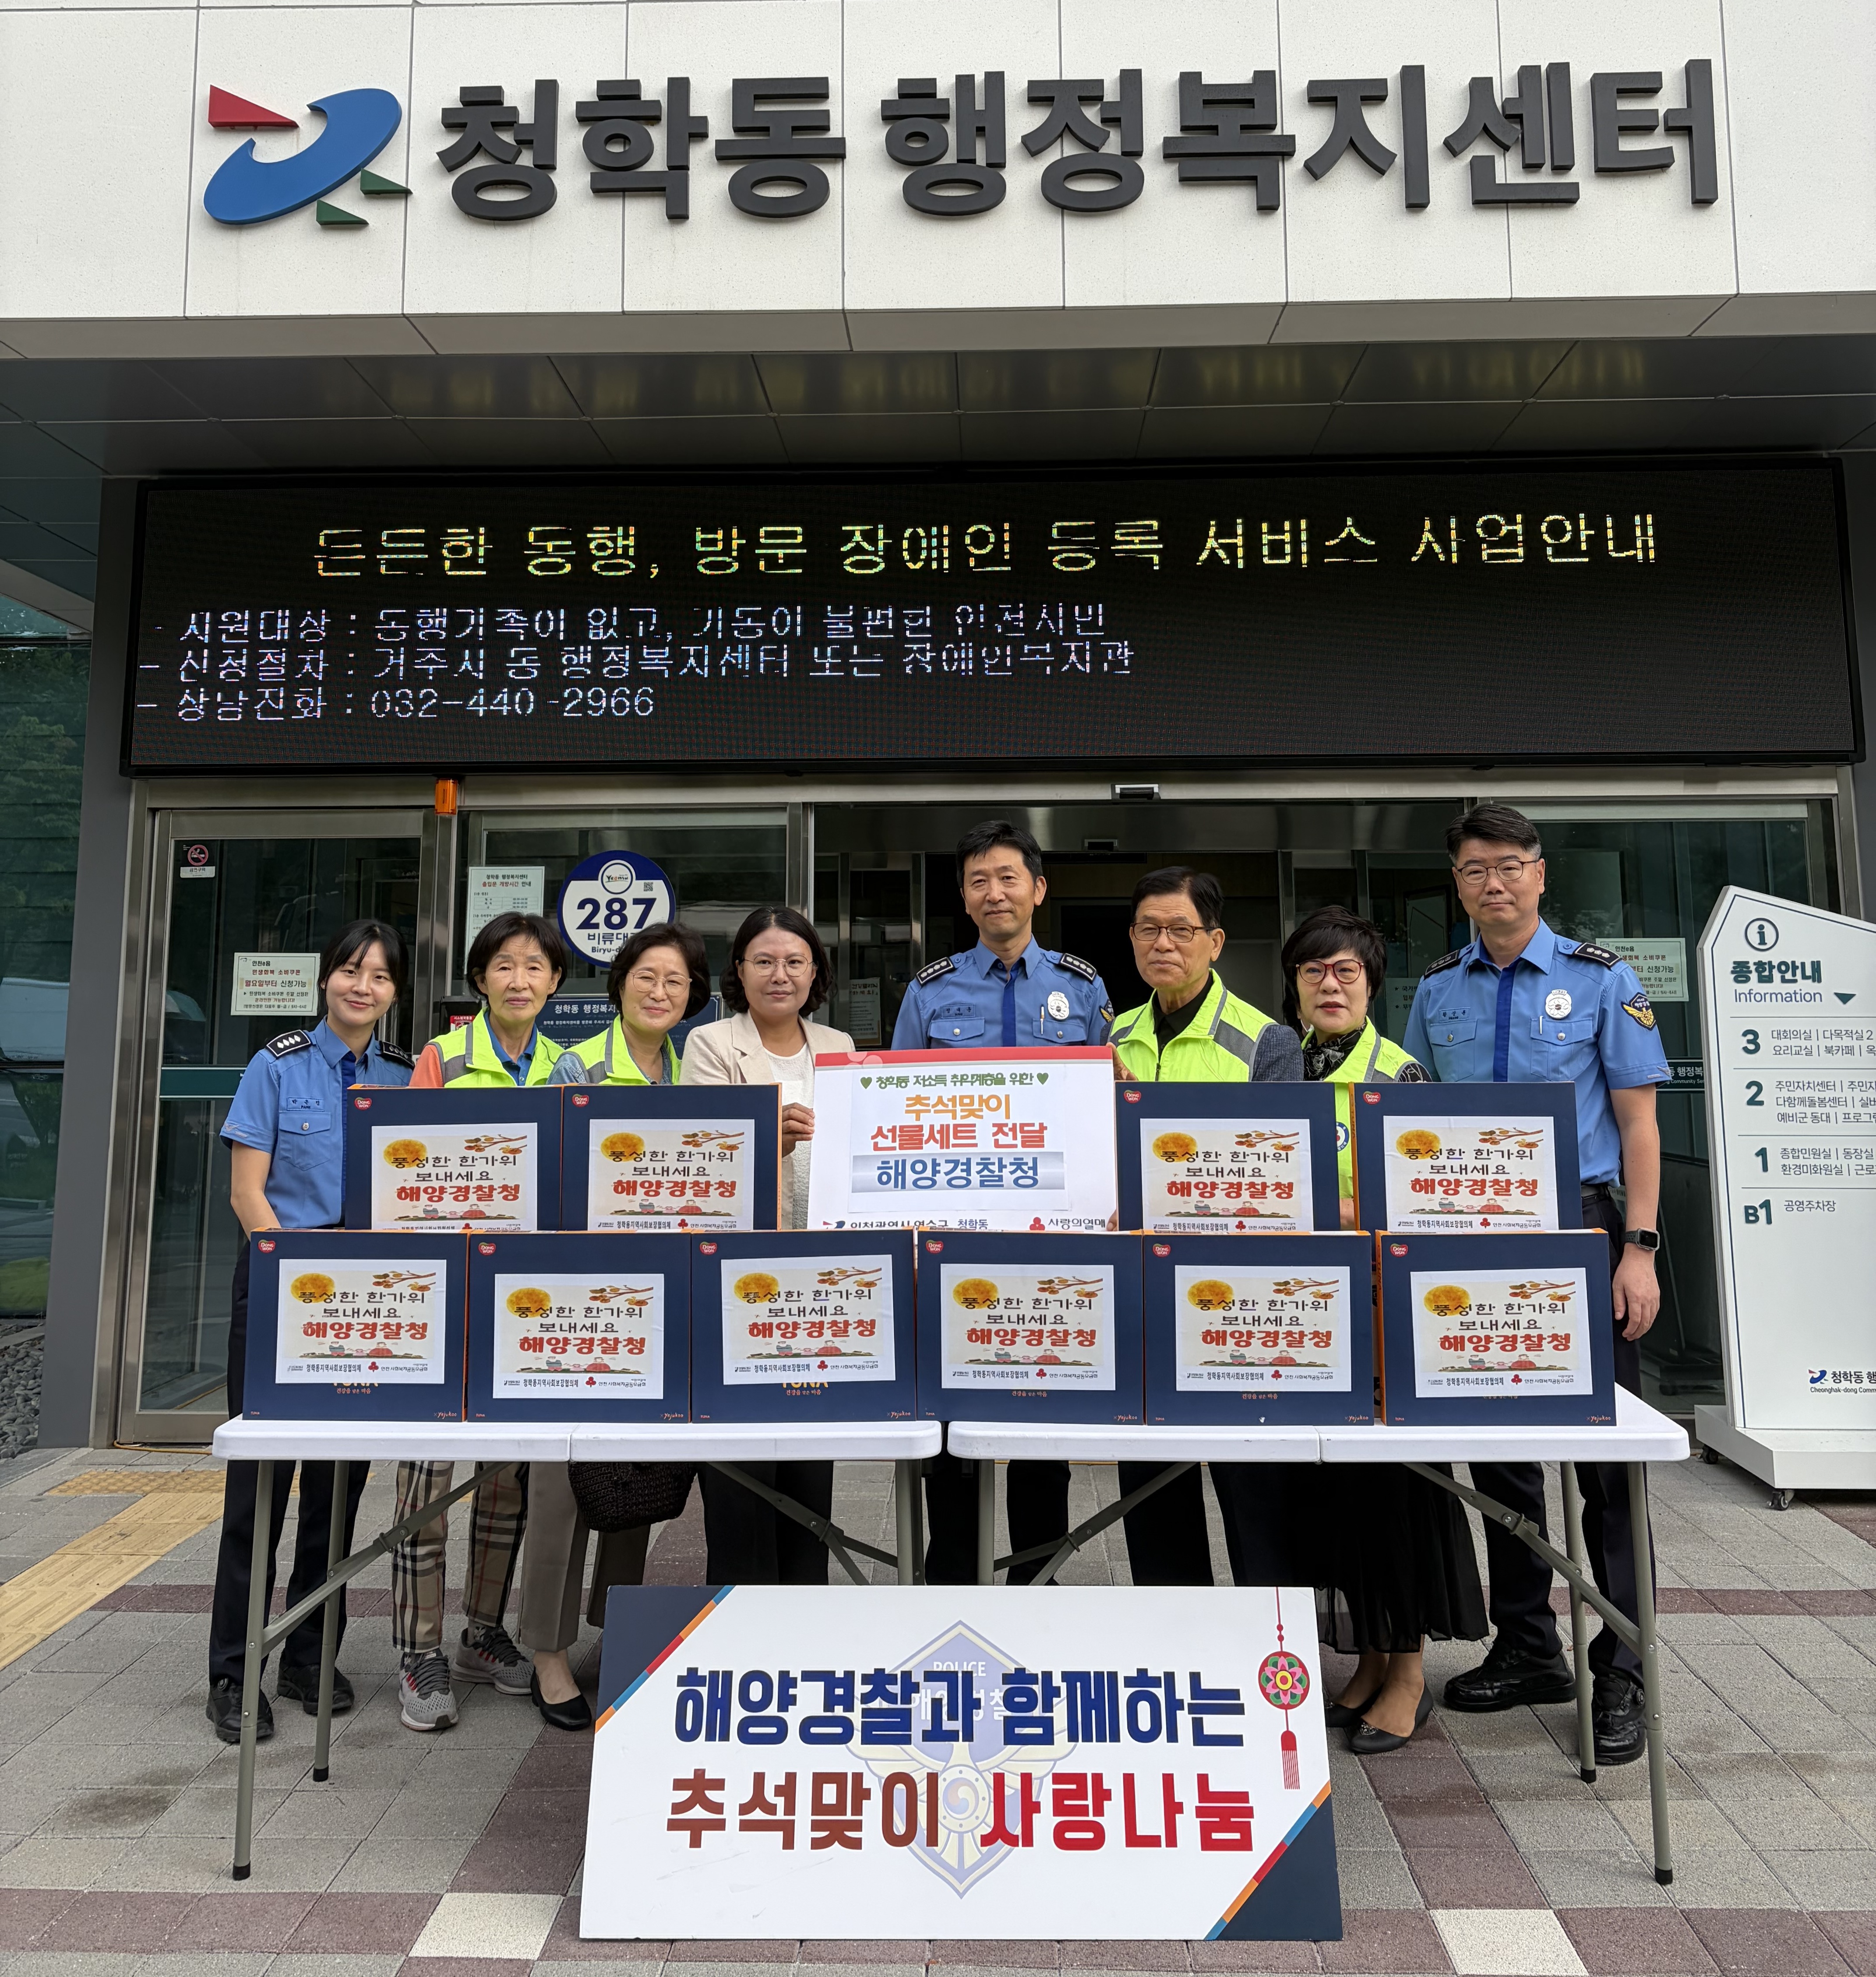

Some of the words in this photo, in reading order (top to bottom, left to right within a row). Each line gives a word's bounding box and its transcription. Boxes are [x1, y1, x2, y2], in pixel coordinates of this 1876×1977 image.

[437, 76, 846, 221] 청학동
[881, 59, 1718, 216] 행정복지센터
[314, 526, 493, 576] 든든한
[523, 525, 658, 578] 동행,
[695, 525, 808, 574] 방문
[840, 523, 1012, 574] 장애인
[1047, 521, 1164, 571] 등록
[1196, 517, 1378, 569] 서비스
[1411, 514, 1655, 564] 사업안내
[371, 687, 654, 717] 032-440-2966
[576, 898, 657, 930] 287
[588, 933, 636, 945] 비류대
[1731, 960, 1822, 983] 종합안내
[1735, 989, 1822, 1003] Information
[555, 1004, 578, 1014] 청학동
[1771, 1029, 1812, 1041] 대회의실
[1823, 1029, 1864, 1041] 다목적실
[1742, 1029, 1761, 1055] 3
[1773, 1045, 1813, 1056] 요리교실
[1824, 1045, 1855, 1056] 북카페
[876, 1076, 910, 1088] 청학동
[913, 1075, 947, 1087] 저소득
[950, 1073, 1006, 1086] 취약계층을
[1009, 1073, 1034, 1085] 위한
[1775, 1080, 1836, 1092] 주민자치센터
[1746, 1080, 1764, 1106] 2
[905, 1094, 1010, 1121] 추석맞이
[1776, 1096, 1848, 1108] 다함께돌봄센터
[1777, 1112, 1808, 1124] 예비군
[1810, 1112, 1830, 1124] 동대
[871, 1124, 978, 1152] 선물세트
[991, 1122, 1047, 1149] 전달
[608, 1151, 668, 1163] 풍성한
[676, 1151, 733, 1163] 한가위
[1160, 1151, 1221, 1163] 풍성한
[1230, 1152, 1289, 1163] 한가위
[1404, 1148, 1465, 1160] 풍성한
[1474, 1149, 1533, 1160] 한가위
[1755, 1147, 1768, 1172] 1
[1780, 1148, 1831, 1159] 종합민원실
[1843, 1148, 1874, 1160] 동장실
[391, 1156, 451, 1169] 풍성한
[458, 1156, 516, 1166] 한가위
[631, 1166, 710, 1177] 보내세요
[877, 1156, 1038, 1190] 해양경찰청
[1185, 1167, 1266, 1178] 보내세요
[1429, 1164, 1510, 1175] 보내세요
[1781, 1164, 1844, 1176] 환경미화원실
[415, 1171, 494, 1182] 보내세요
[396, 1184, 520, 1203] 해양경찰청
[613, 1180, 737, 1198] 해양경찰청
[1167, 1181, 1294, 1199] 해양경찰청
[1410, 1178, 1538, 1196] 해양경찰청
[1744, 1199, 1772, 1225] B1
[1784, 1200, 1836, 1212] 공영주차장
[1048, 1218, 1105, 1230] 사랑의열매
[298, 1291, 359, 1304] 풍성한
[367, 1292, 425, 1303] 한가위
[742, 1290, 804, 1303] 풍성한
[812, 1289, 872, 1301] 한가위
[961, 1297, 1023, 1310] 풍성한
[1032, 1298, 1092, 1310] 한가위
[1195, 1299, 1259, 1311] 풍성한
[1267, 1300, 1328, 1311] 한가위
[1432, 1304, 1496, 1316] 풍성한
[1504, 1303, 1566, 1314] 한가위
[321, 1307, 401, 1318] 보내세요
[514, 1306, 575, 1318] 풍성한
[583, 1307, 642, 1318] 한가위
[767, 1305, 848, 1318] 보내세요
[986, 1314, 1068, 1325] 보내세요
[1221, 1315, 1304, 1326] 보내세요
[1459, 1319, 1542, 1331] 보내세요
[302, 1322, 428, 1340] 해양경찰청
[539, 1322, 619, 1333] 보내세요
[748, 1319, 876, 1339] 해양경찰청
[966, 1328, 1097, 1347] 해양경찰청
[1201, 1329, 1332, 1348] 해양경찰청
[1439, 1333, 1571, 1353] 해양경찰청
[519, 1336, 646, 1355] 해양경찰청
[1831, 1371, 1864, 1384] 청학동
[674, 1666, 982, 1745] 해양경찰과
[1000, 1667, 1247, 1748] 함께하는
[666, 1768, 939, 1851] 추석맞이
[980, 1771, 1255, 1852] 사랑나눔
